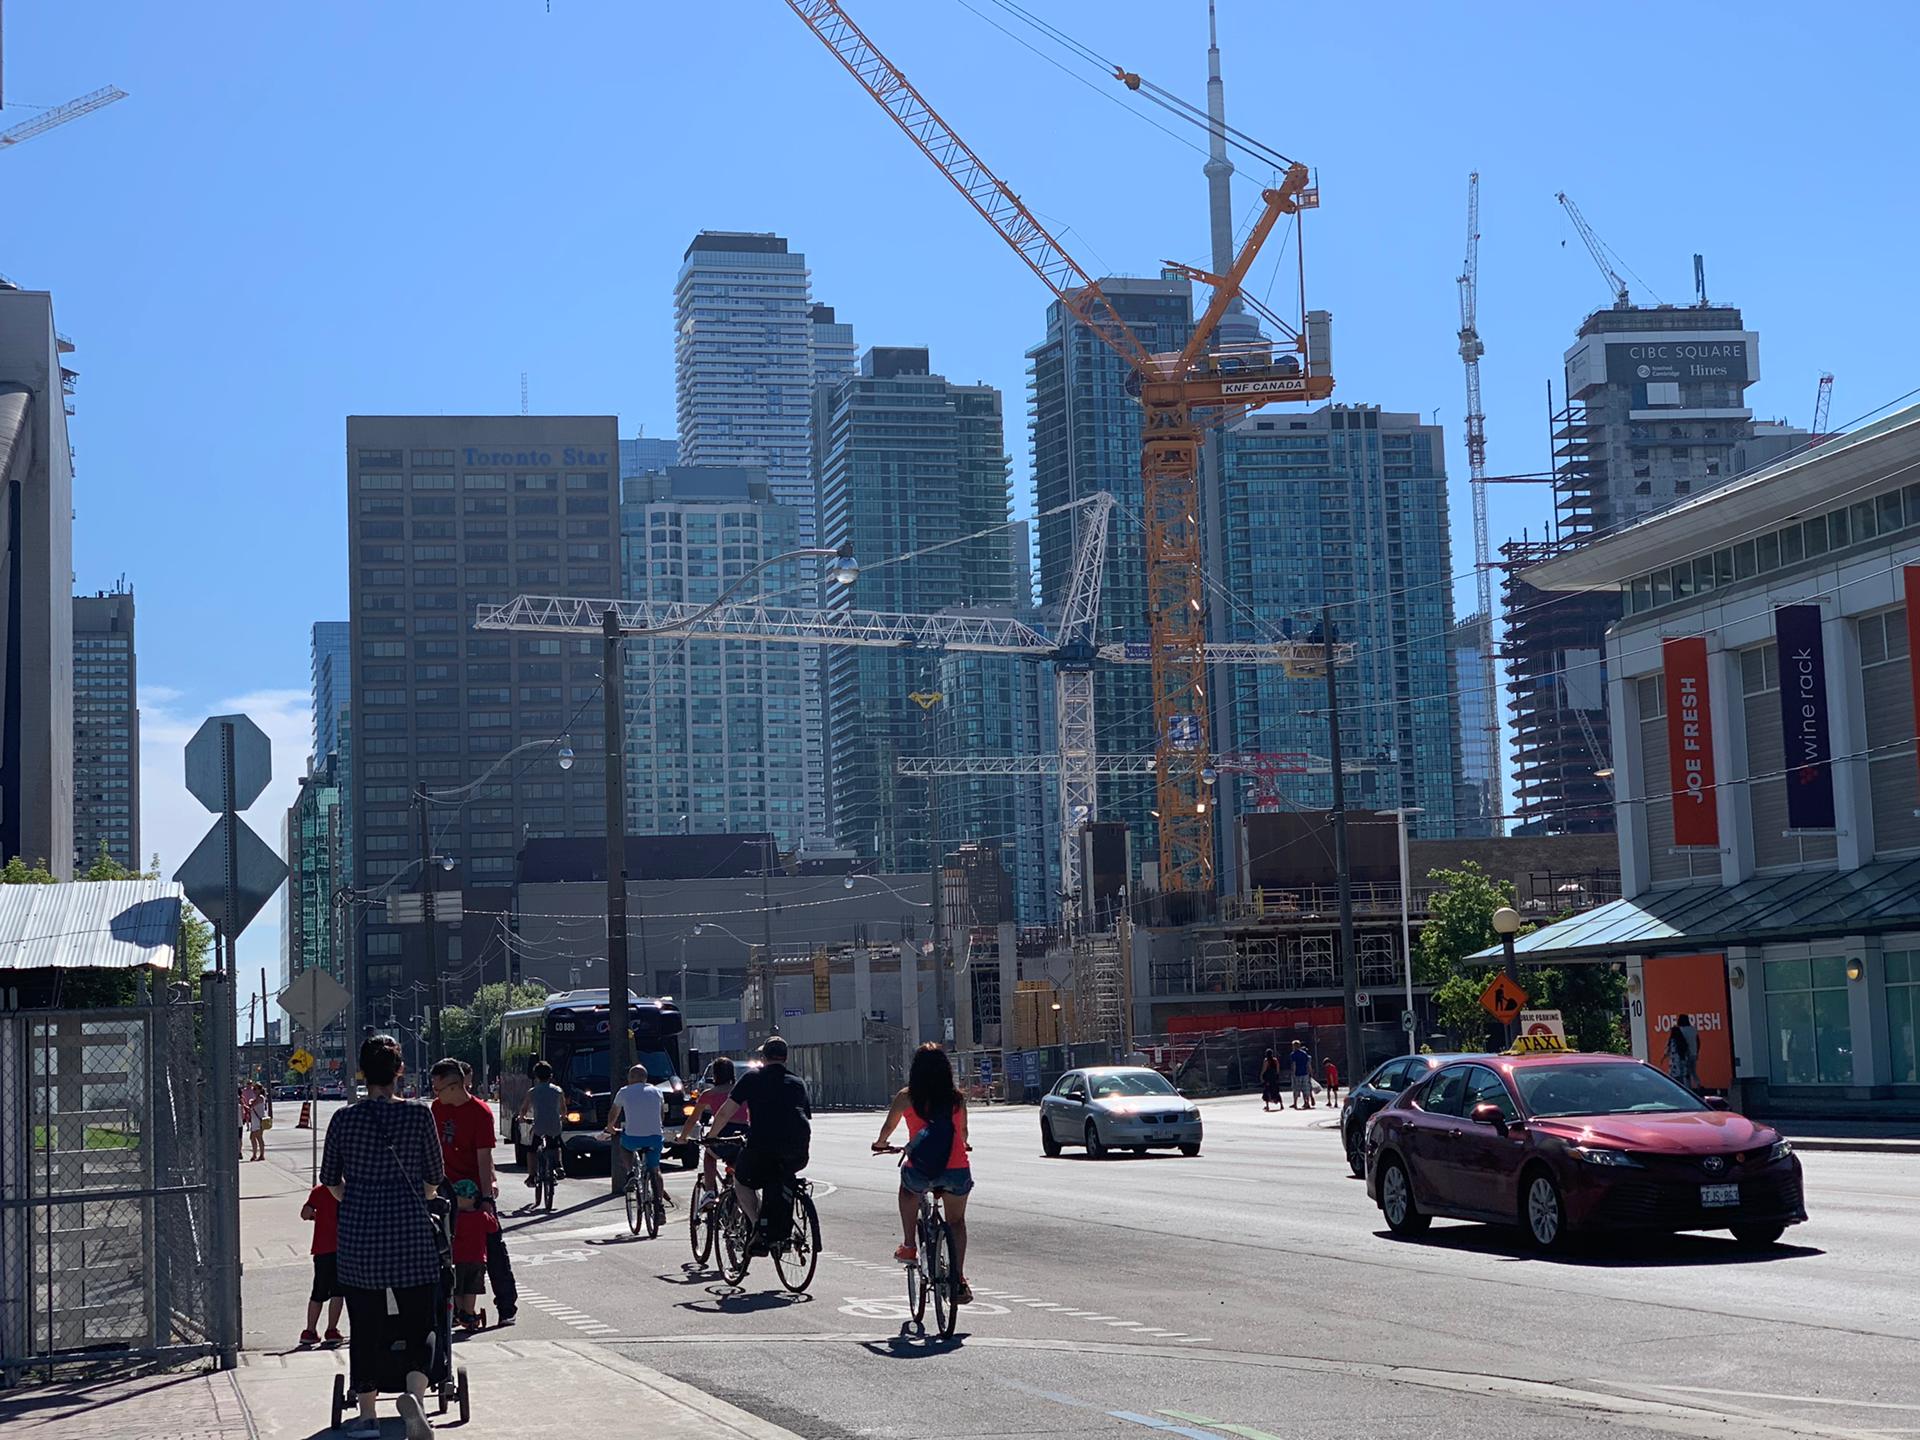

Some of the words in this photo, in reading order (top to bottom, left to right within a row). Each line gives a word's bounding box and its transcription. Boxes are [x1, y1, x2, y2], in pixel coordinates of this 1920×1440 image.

[1630, 346, 1668, 359] CIBC
[1676, 345, 1741, 359] SQUARE
[1690, 364, 1728, 376] Hines
[1225, 383, 1249, 393] KNF
[1253, 380, 1302, 391] CANADA
[463, 448, 551, 465] Toronto
[563, 448, 608, 465] Star
[1792, 648, 1814, 698] rack
[1680, 678, 1700, 750] FRESH
[1799, 704, 1818, 760] wine
[1685, 759, 1703, 803] JOE
[1631, 999, 1643, 1017] 10
[1519, 1035, 1563, 1050] TAXI
